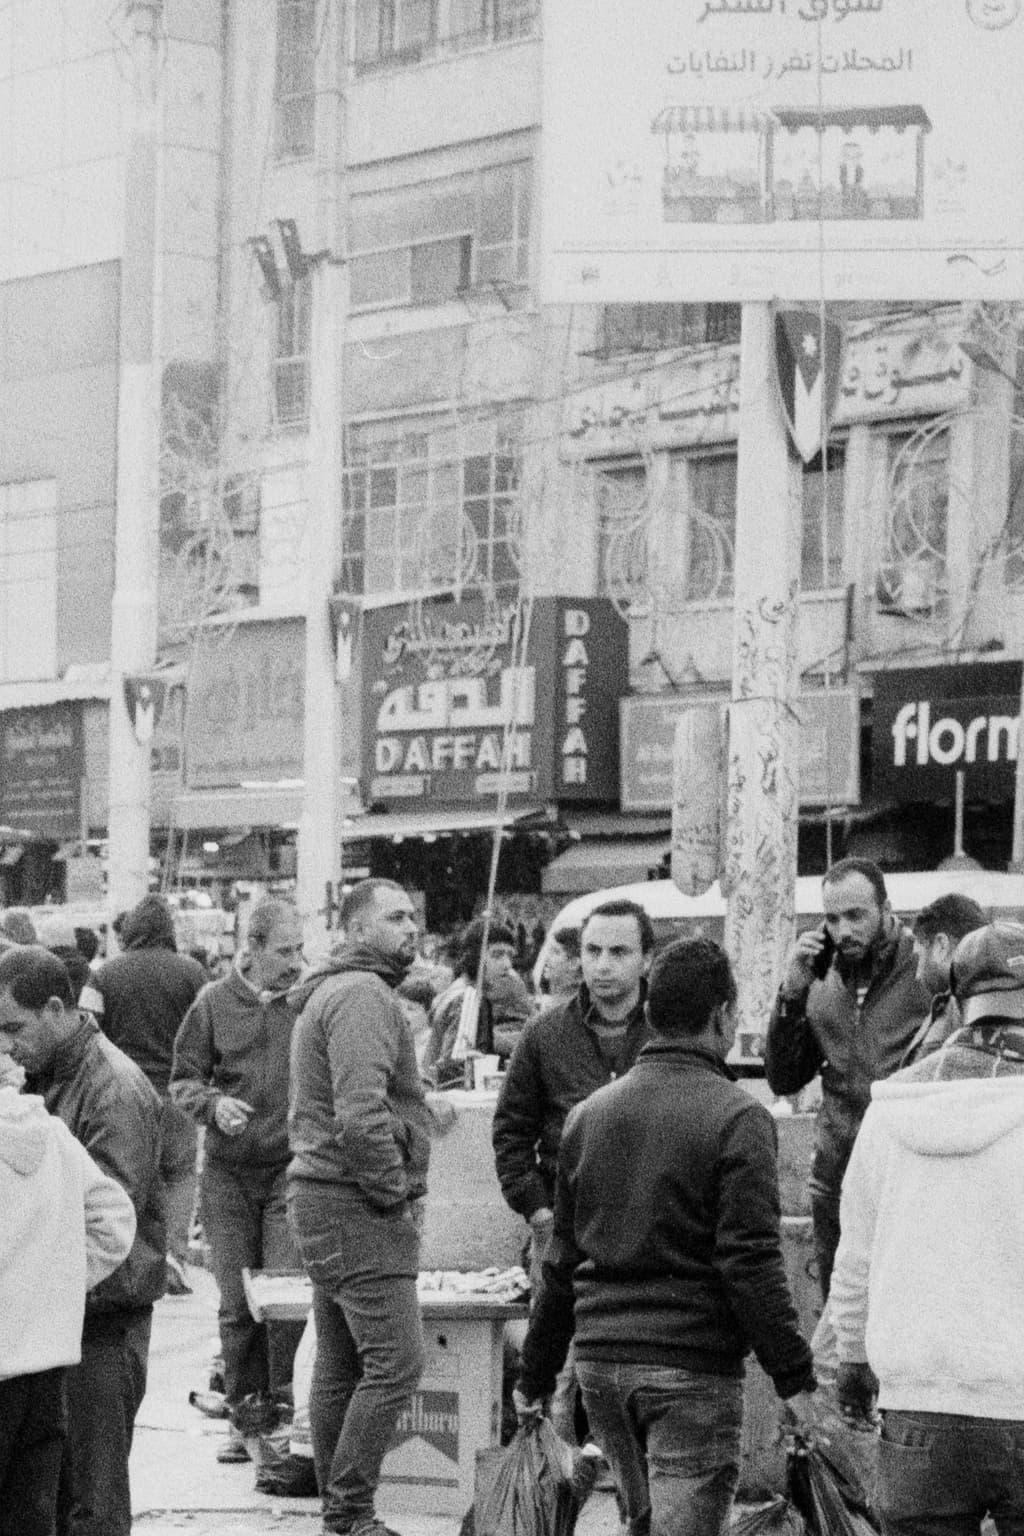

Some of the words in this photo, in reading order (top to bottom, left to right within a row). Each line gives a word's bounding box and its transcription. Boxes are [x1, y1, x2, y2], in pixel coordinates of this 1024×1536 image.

[667, 47, 755, 79] النفايات
[762, 48, 812, 79] تفرز
[820, 47, 913, 74] المحلات
[561, 608, 591, 784] DAFFAH
[376, 731, 532, 772] DAFFAH
